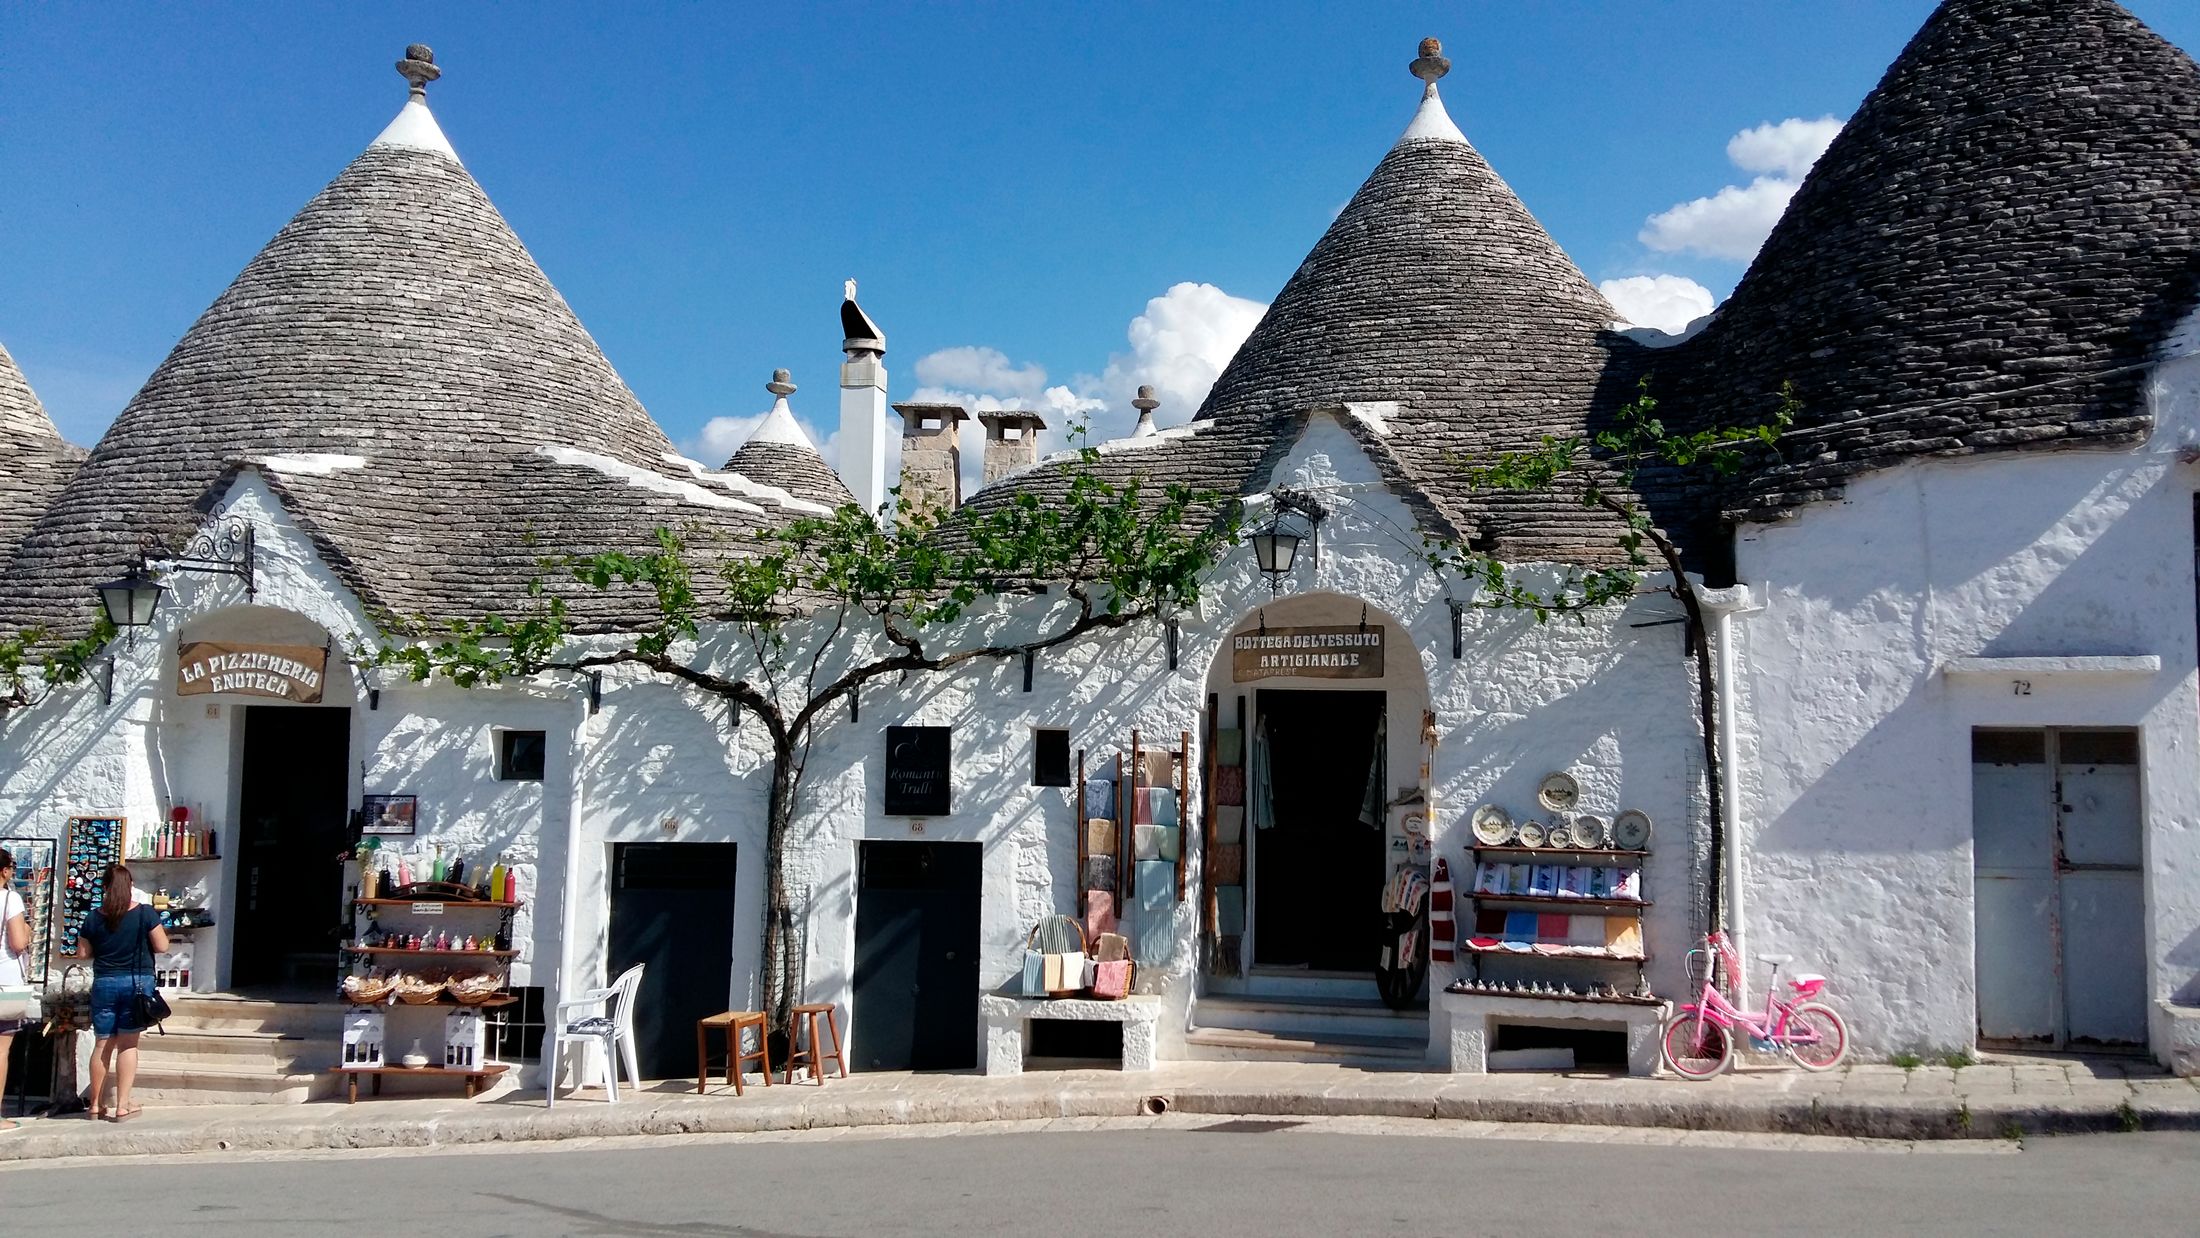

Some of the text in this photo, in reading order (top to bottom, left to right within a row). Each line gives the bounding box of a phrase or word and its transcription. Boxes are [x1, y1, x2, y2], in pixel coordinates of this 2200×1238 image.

[1235, 636, 1291, 649] BOTTEGA
[1260, 653, 1359, 667] ARTIGIANALE
[181, 652, 320, 688] LA PIZZICHERIA
[211, 672, 289, 696] ENOTECA
[2012, 680, 2031, 695] 72
[911, 822, 923, 832] 68
